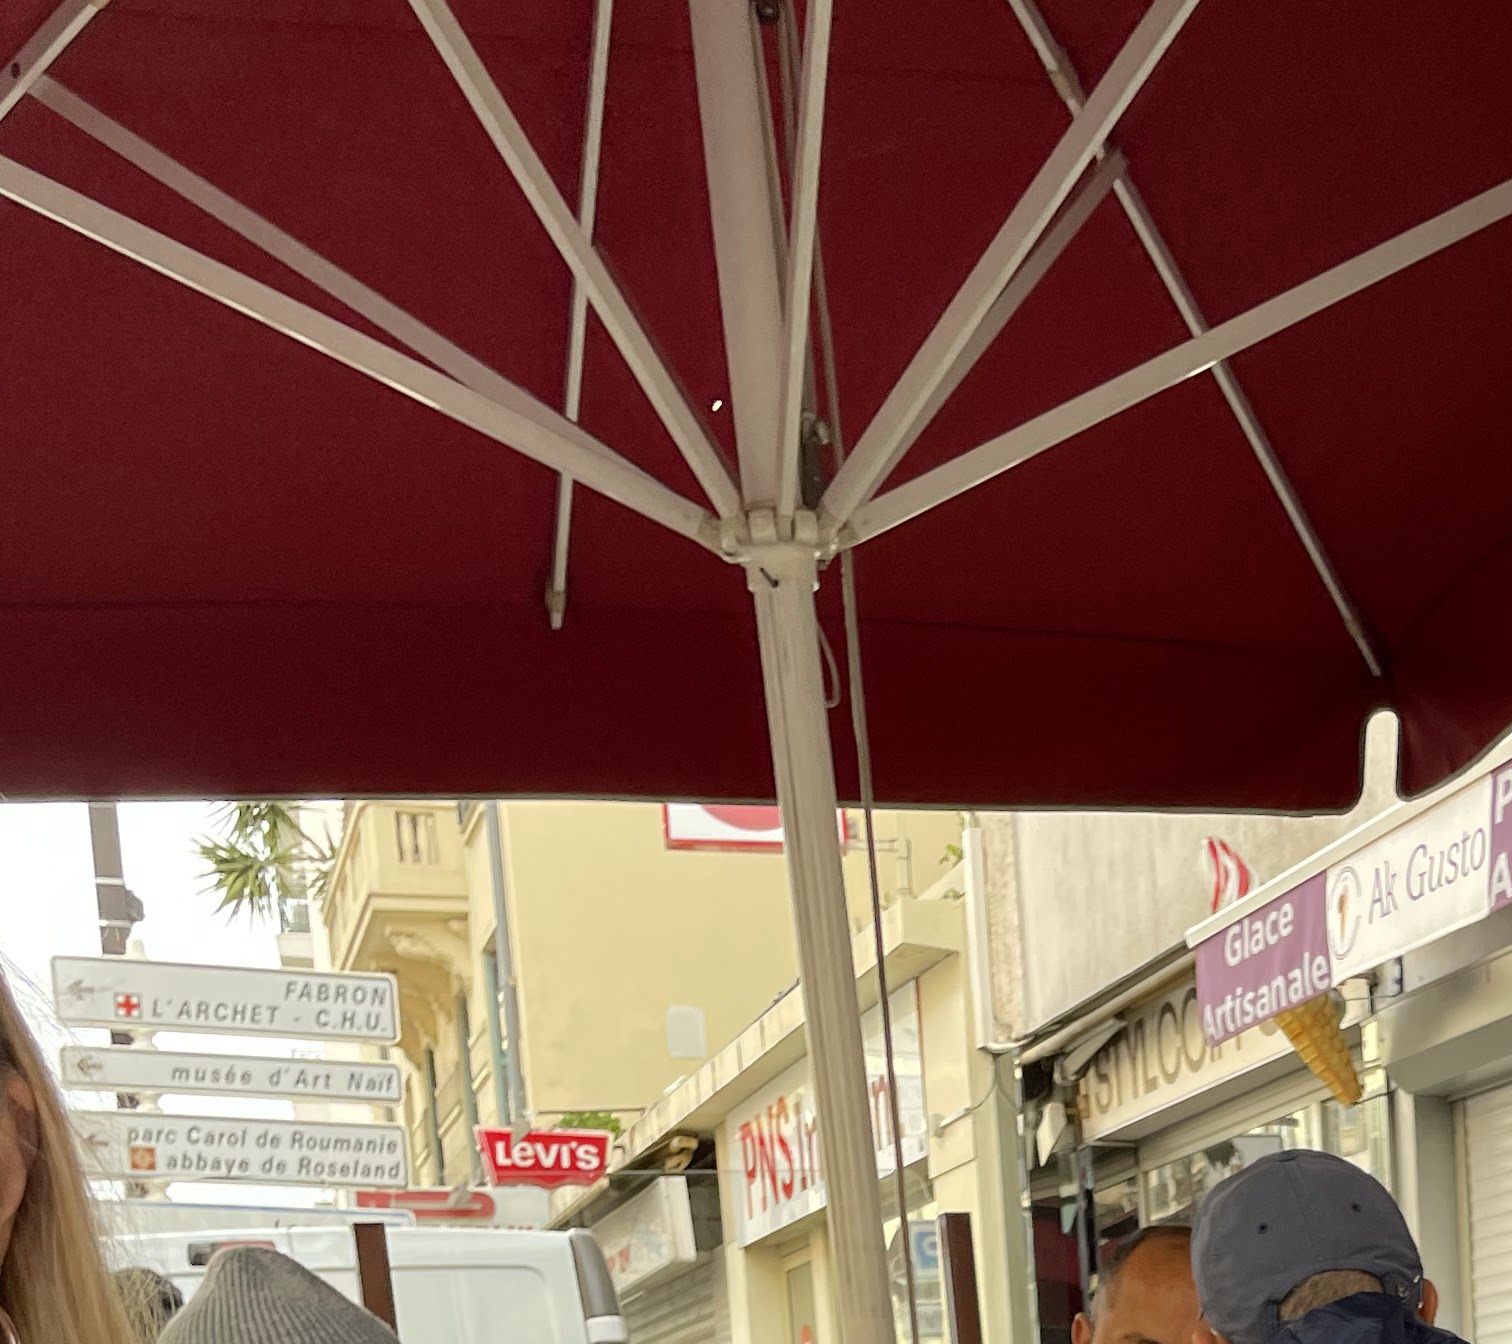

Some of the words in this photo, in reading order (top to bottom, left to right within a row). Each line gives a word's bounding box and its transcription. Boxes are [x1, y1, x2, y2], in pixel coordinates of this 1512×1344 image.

[1368, 860, 1399, 924] Ak
[1405, 827, 1488, 902] Gusto
[1224, 902, 1295, 967] Glace
[285, 980, 388, 1007] FABRON
[1203, 951, 1332, 1041] Artisanale
[152, 998, 280, 1025] L'ARCHET
[315, 1009, 388, 1032] C.H.U.
[171, 1064, 253, 1086] musée
[268, 1067, 331, 1090] d'Art
[346, 1072, 395, 1094] Naïf
[127, 1126, 178, 1150] parc
[187, 1125, 247, 1148] Carol
[255, 1129, 281, 1150] de
[291, 1130, 399, 1155] Roumanie
[166, 1152, 250, 1176] abbaye
[261, 1154, 287, 1174] de
[299, 1157, 401, 1180] Roseland
